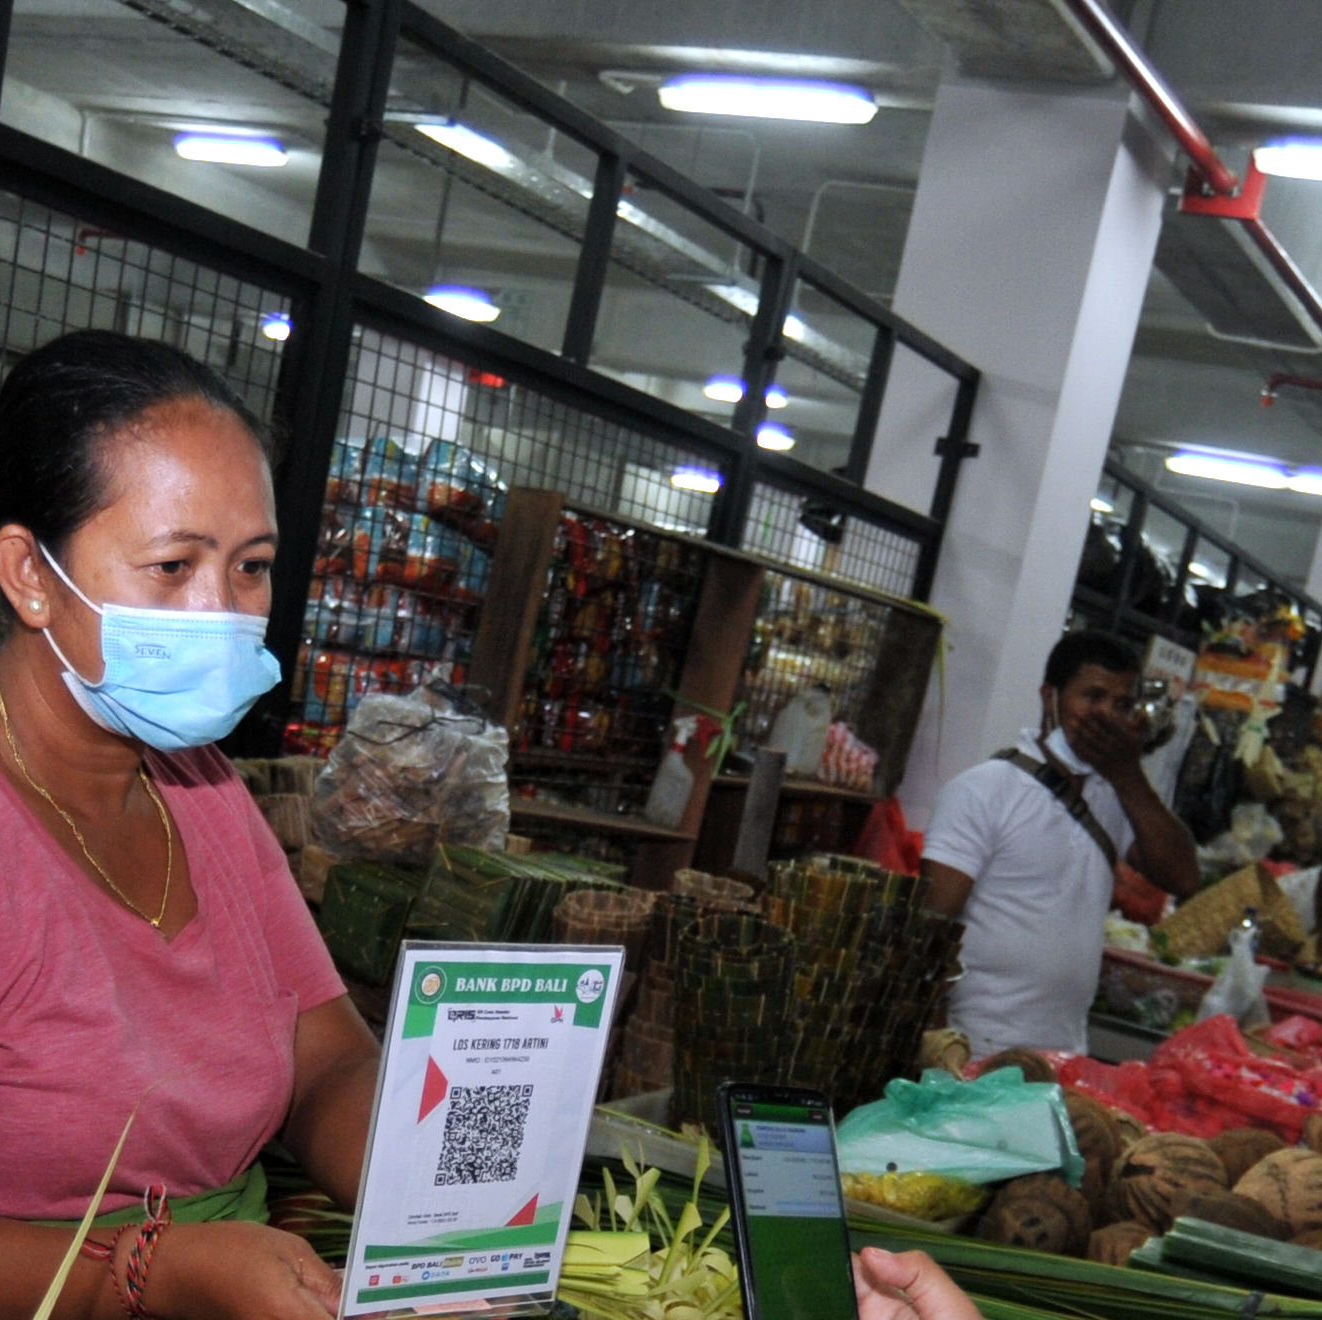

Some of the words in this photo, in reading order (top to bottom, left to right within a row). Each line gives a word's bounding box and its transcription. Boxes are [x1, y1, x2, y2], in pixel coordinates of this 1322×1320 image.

[455, 977, 498, 993] BANK
[501, 979, 532, 993] BPD
[535, 978, 568, 993] BALI
[453, 1039, 469, 1051] LOS
[471, 1039, 501, 1050] KERING
[522, 1037, 549, 1049] ARTINI
